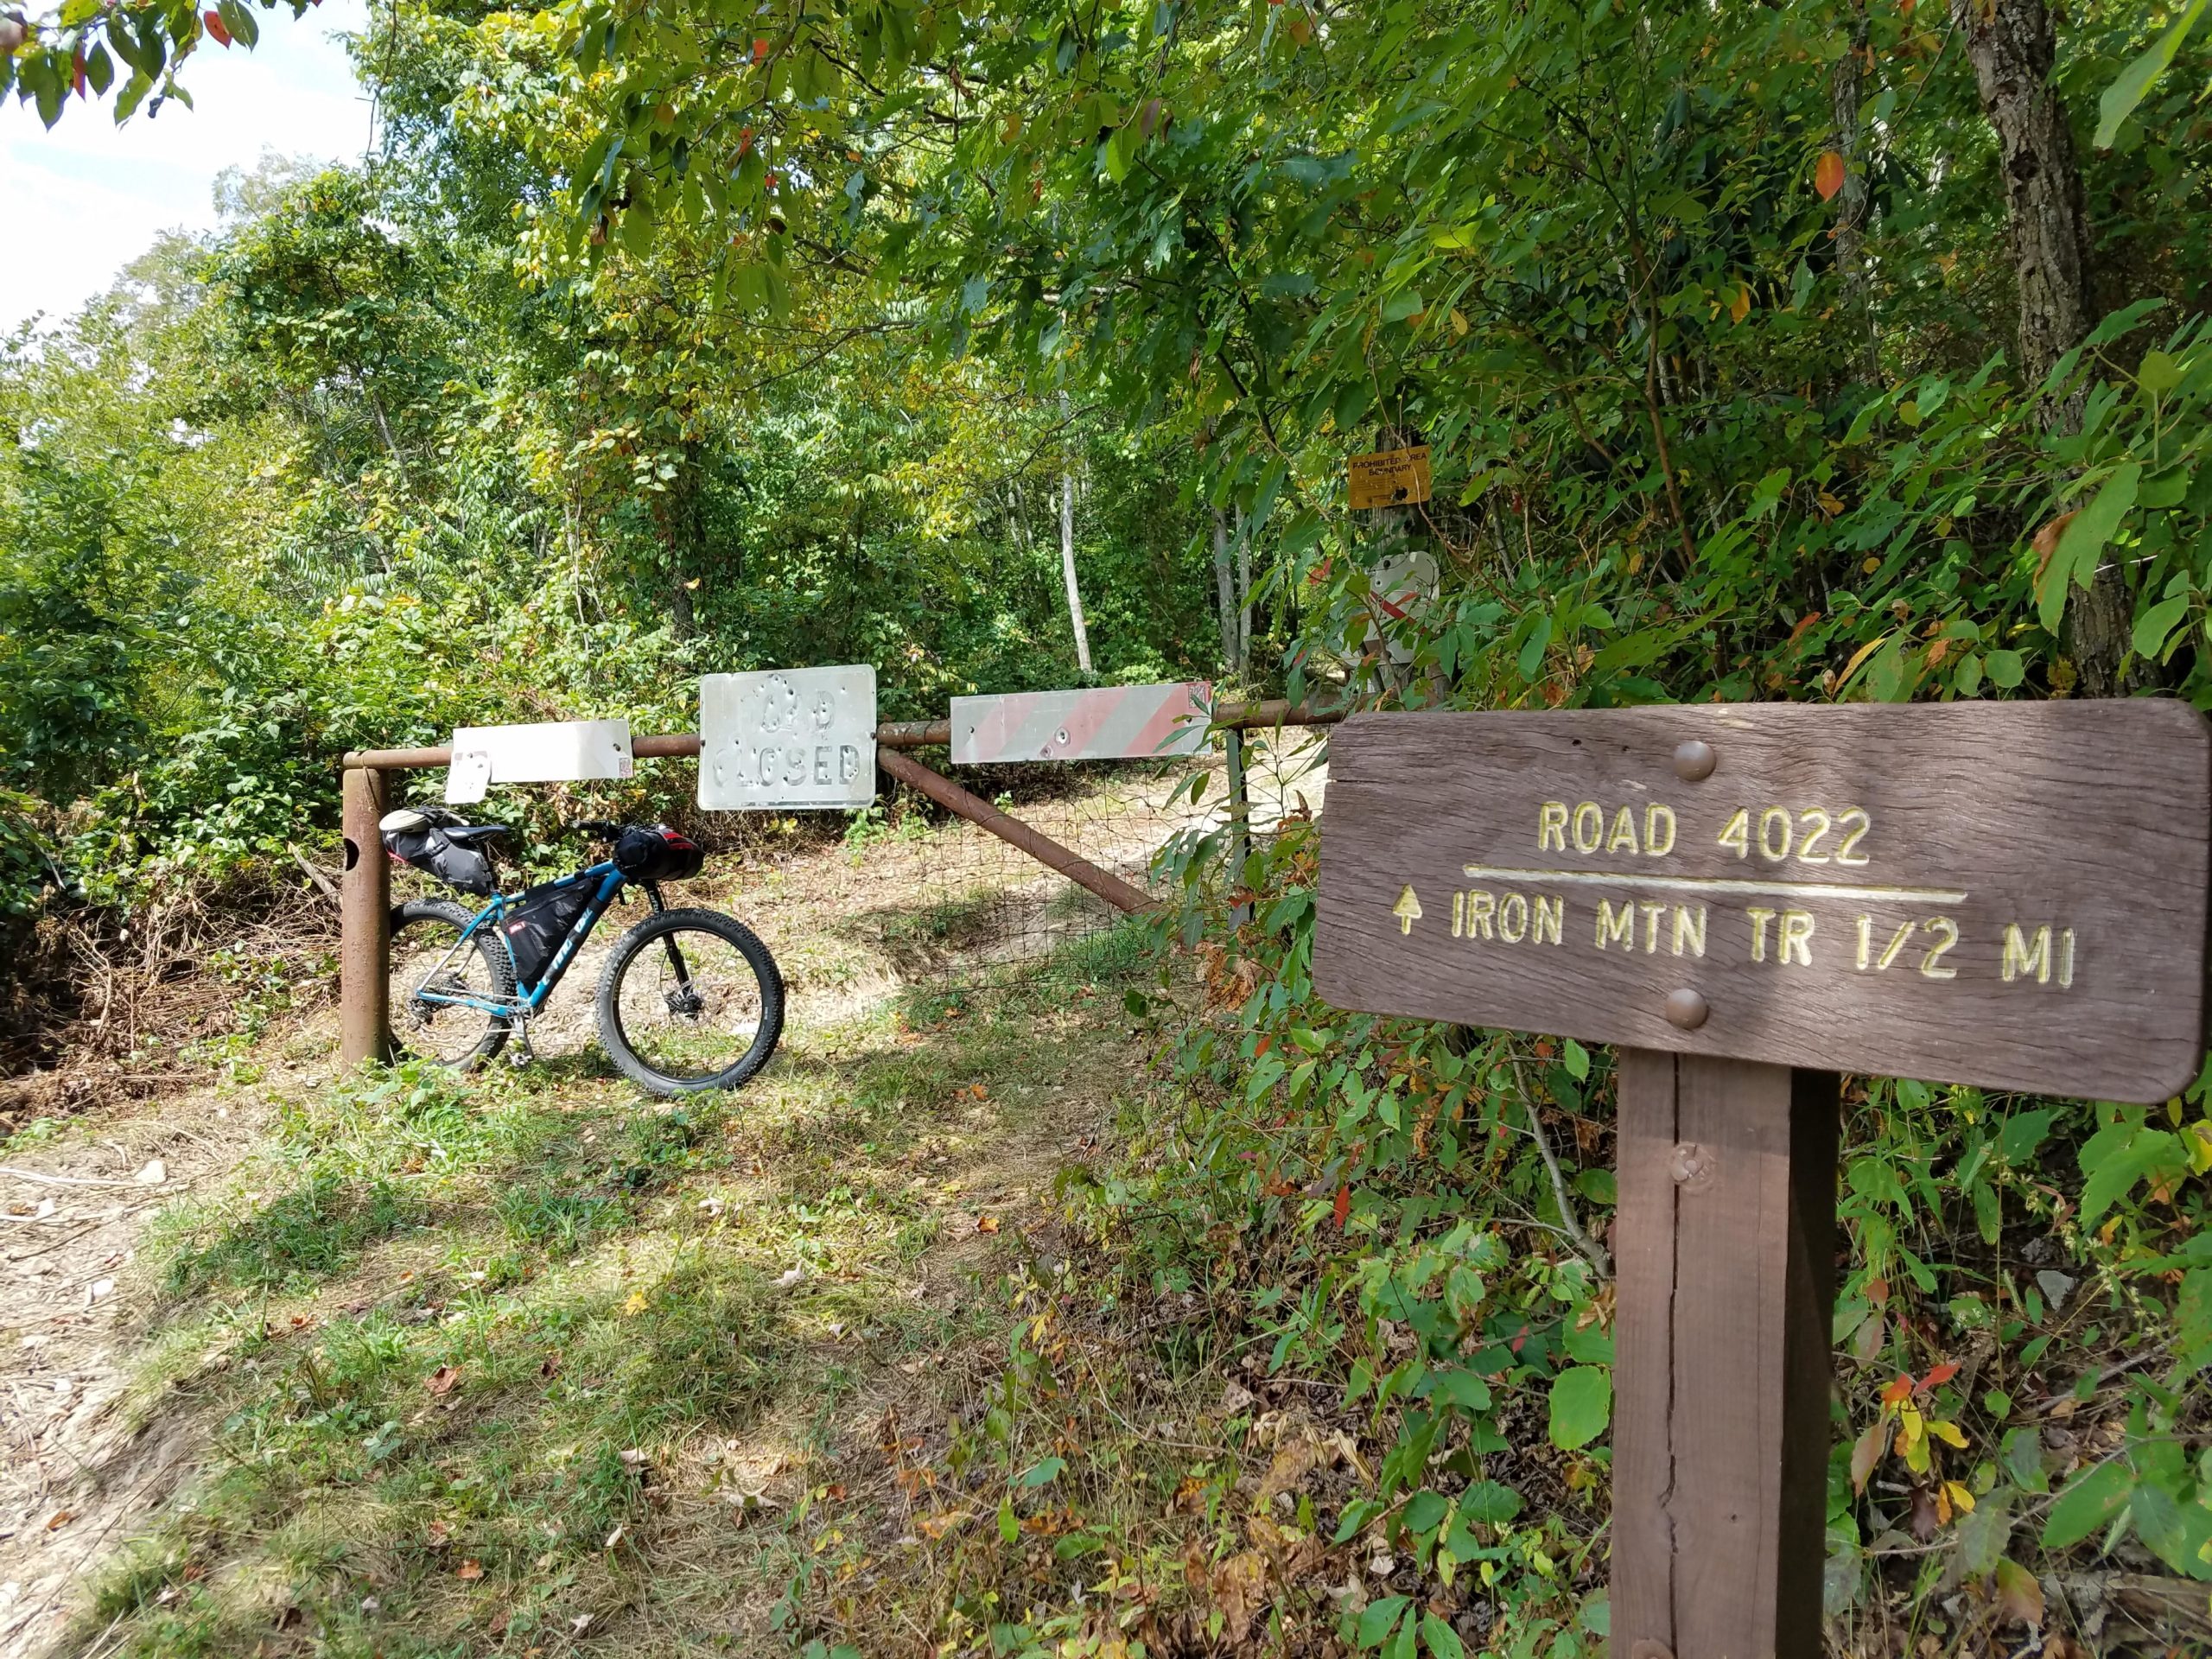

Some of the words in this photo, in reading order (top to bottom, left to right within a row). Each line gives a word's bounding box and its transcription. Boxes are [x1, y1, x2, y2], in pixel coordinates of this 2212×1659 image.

[1405, 452, 1427, 462] REA
[1538, 800, 1677, 856] ROAD
[1718, 804, 1872, 865] 4022
[1451, 888, 1564, 947] IRON
[1594, 896, 1708, 958] MTN
[1747, 906, 1815, 967] TR
[1856, 913, 1960, 979] 1/2
[2001, 921, 2075, 989] MI
